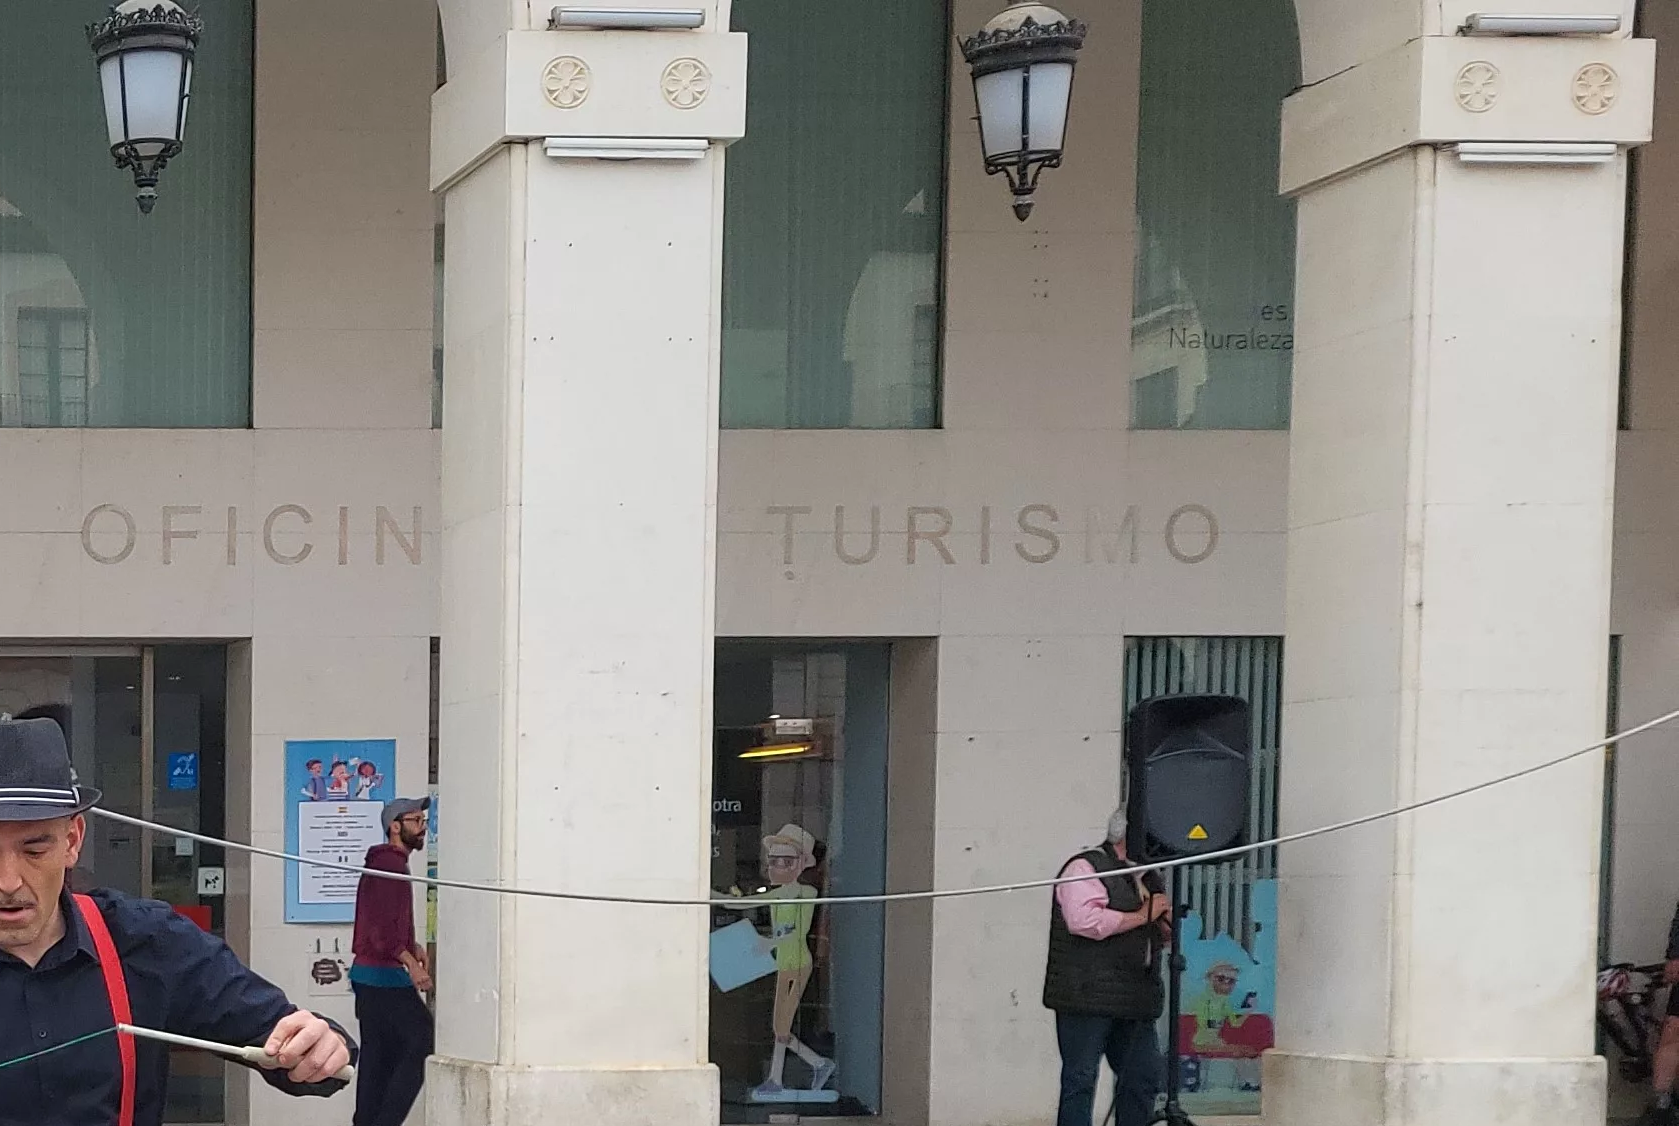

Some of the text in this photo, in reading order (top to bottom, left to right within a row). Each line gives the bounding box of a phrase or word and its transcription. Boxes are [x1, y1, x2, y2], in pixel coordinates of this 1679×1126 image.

[1169, 326, 1294, 350] Naturaleza
[81, 503, 422, 566] OFICIN
[765, 503, 1220, 565] TURISMO
